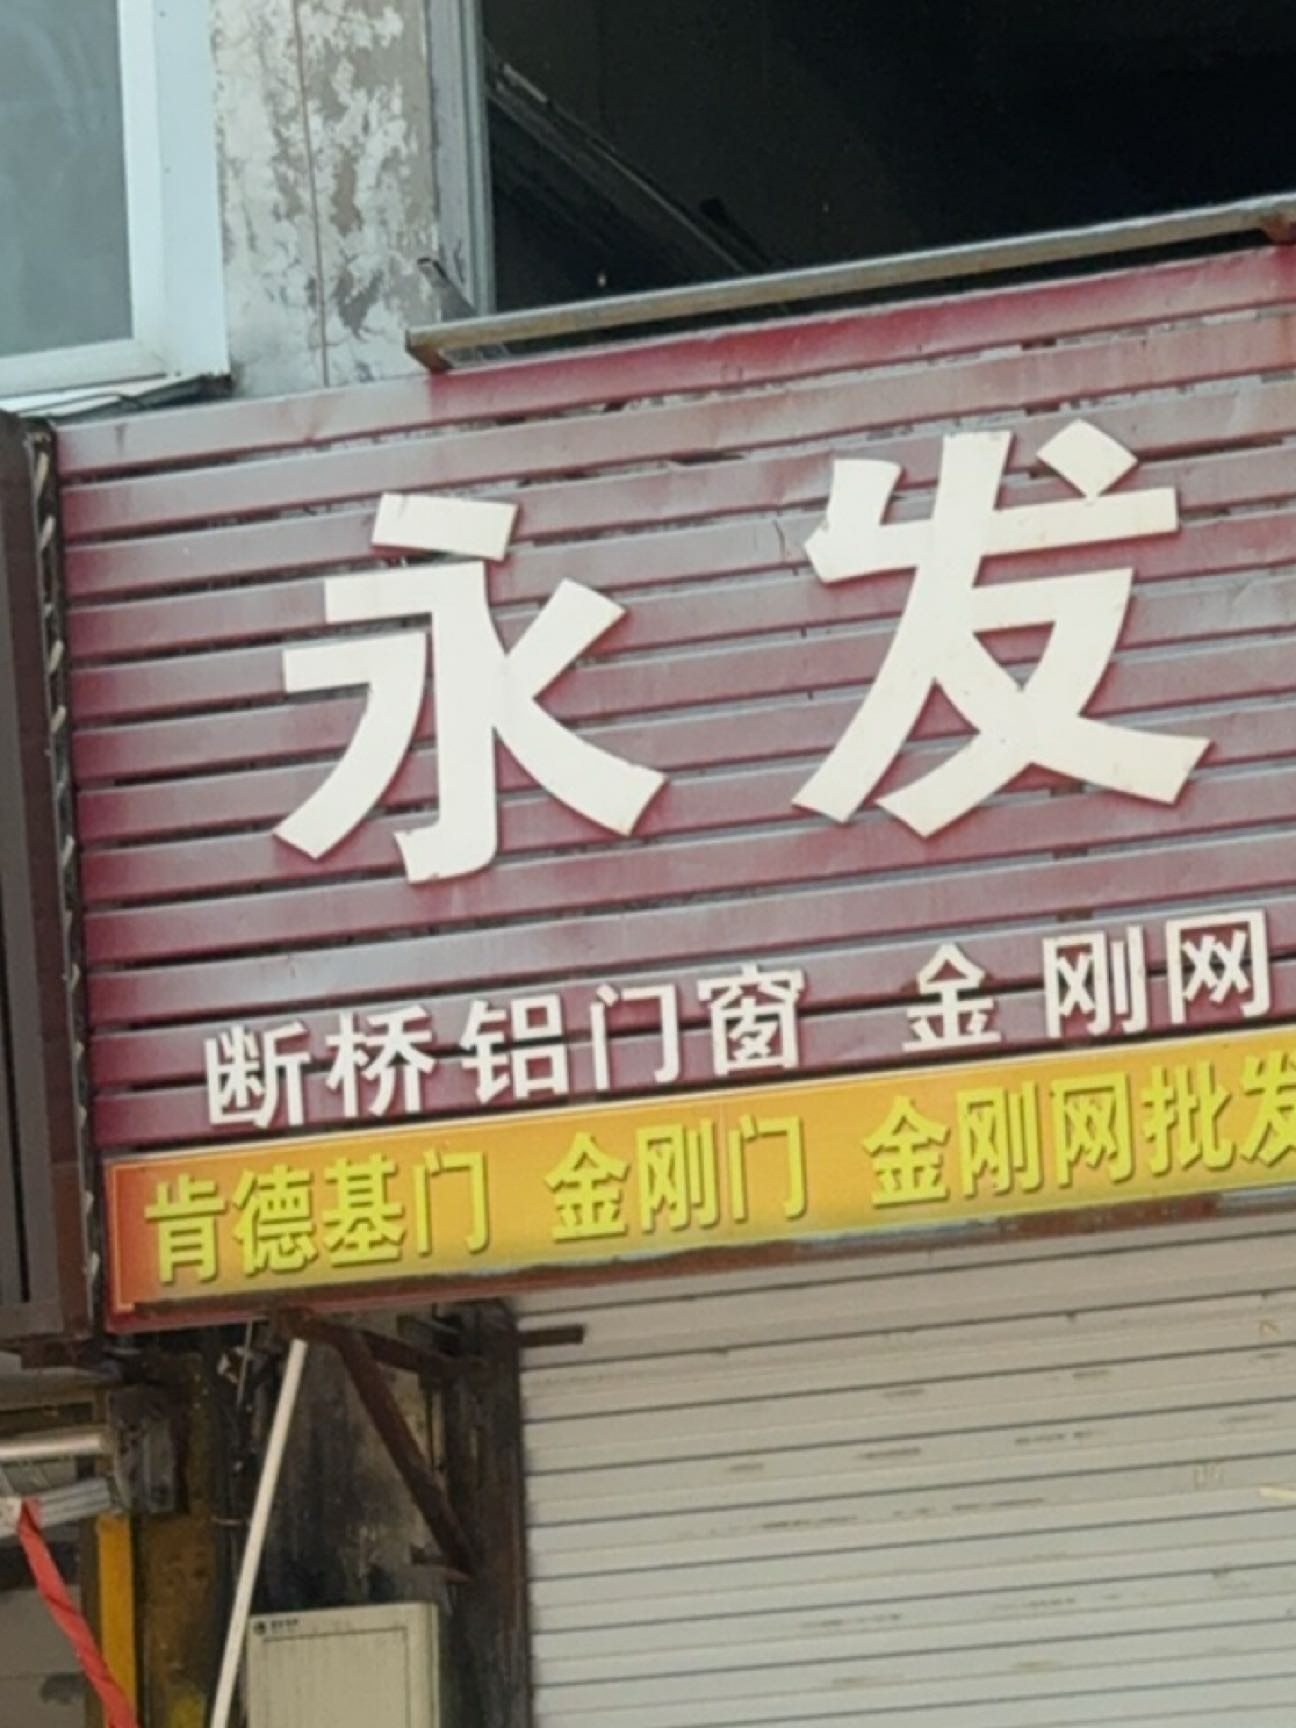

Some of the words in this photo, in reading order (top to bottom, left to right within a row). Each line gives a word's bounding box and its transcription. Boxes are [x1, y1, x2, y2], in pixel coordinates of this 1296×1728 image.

[203, 964, 806, 1128] 断桥铝门窗
[902, 909, 1273, 1052] 金刚网
[144, 1148, 488, 1284] 肯德基门
[543, 1115, 808, 1242] 金刚门
